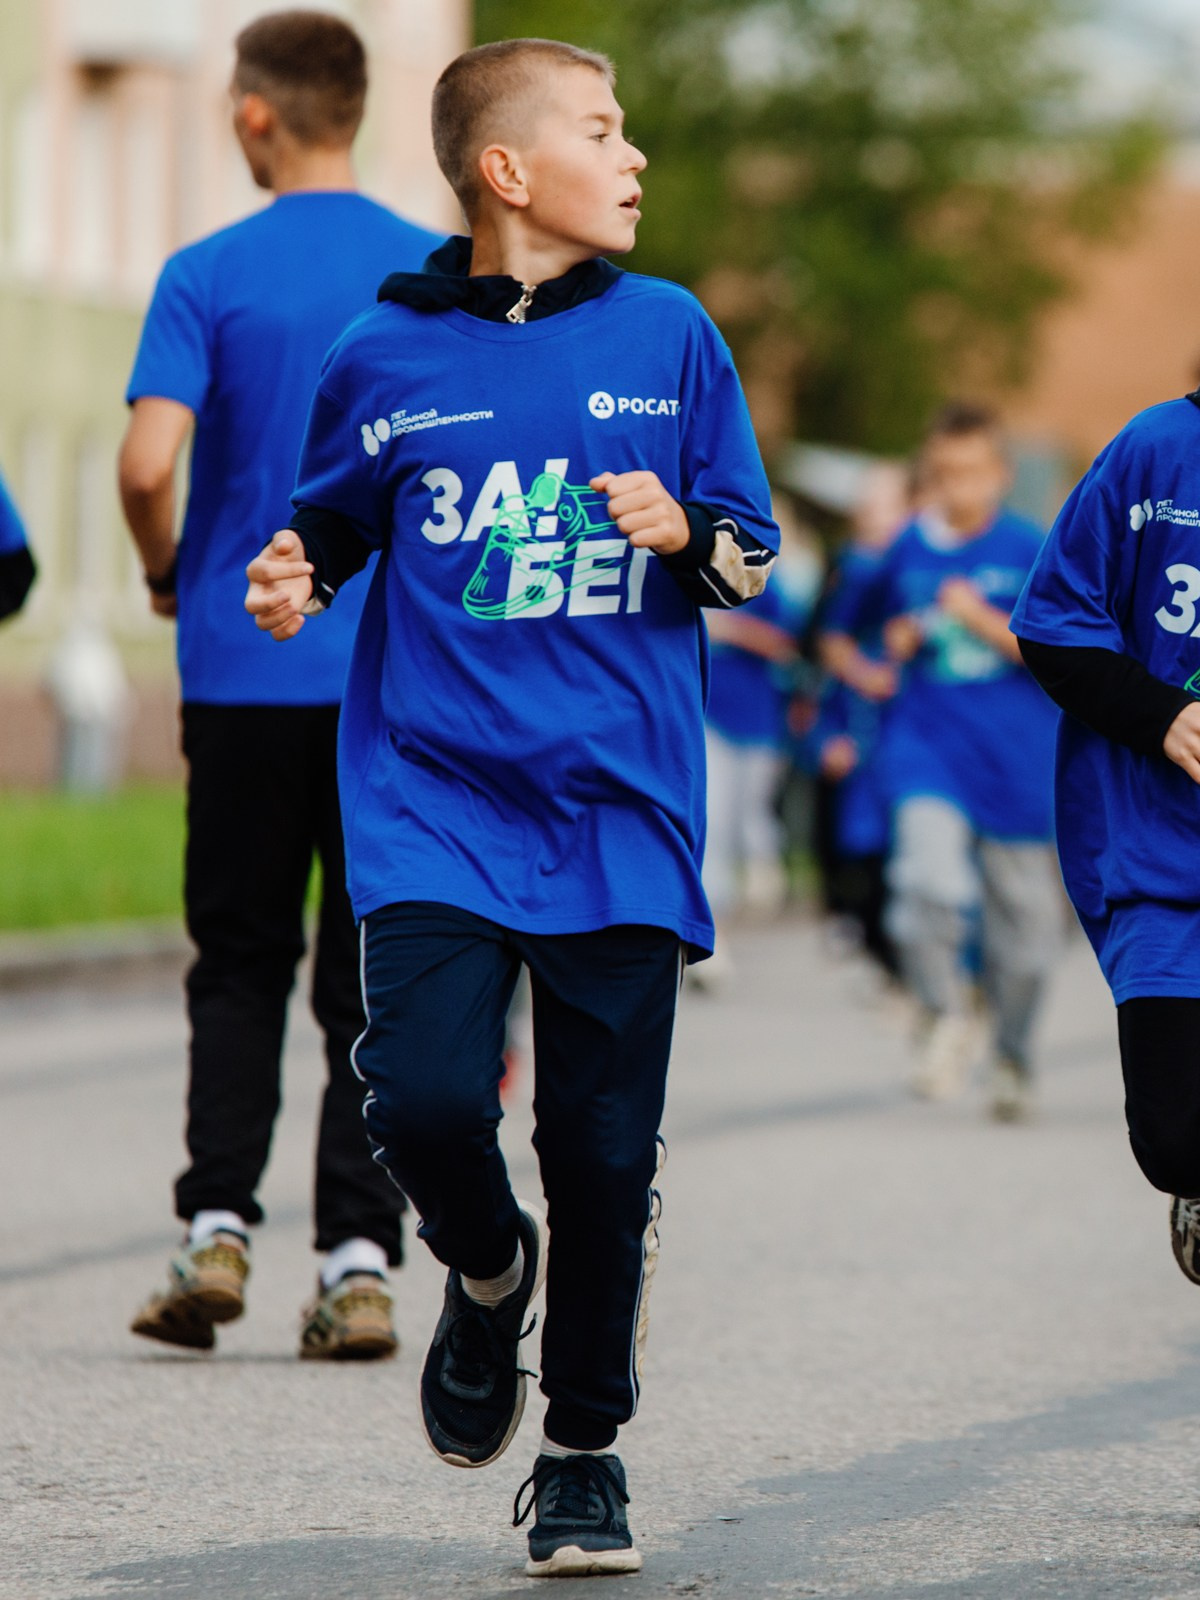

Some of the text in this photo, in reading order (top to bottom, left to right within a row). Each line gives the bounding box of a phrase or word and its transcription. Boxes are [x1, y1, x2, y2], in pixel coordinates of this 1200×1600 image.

[617, 397, 681, 417] РОСАТ
[391, 410, 494, 437] ПРОМЫШЛЕННОСТИ
[420, 457, 569, 545] ЗА!
[1156, 499, 1174, 508] ЛЕТ
